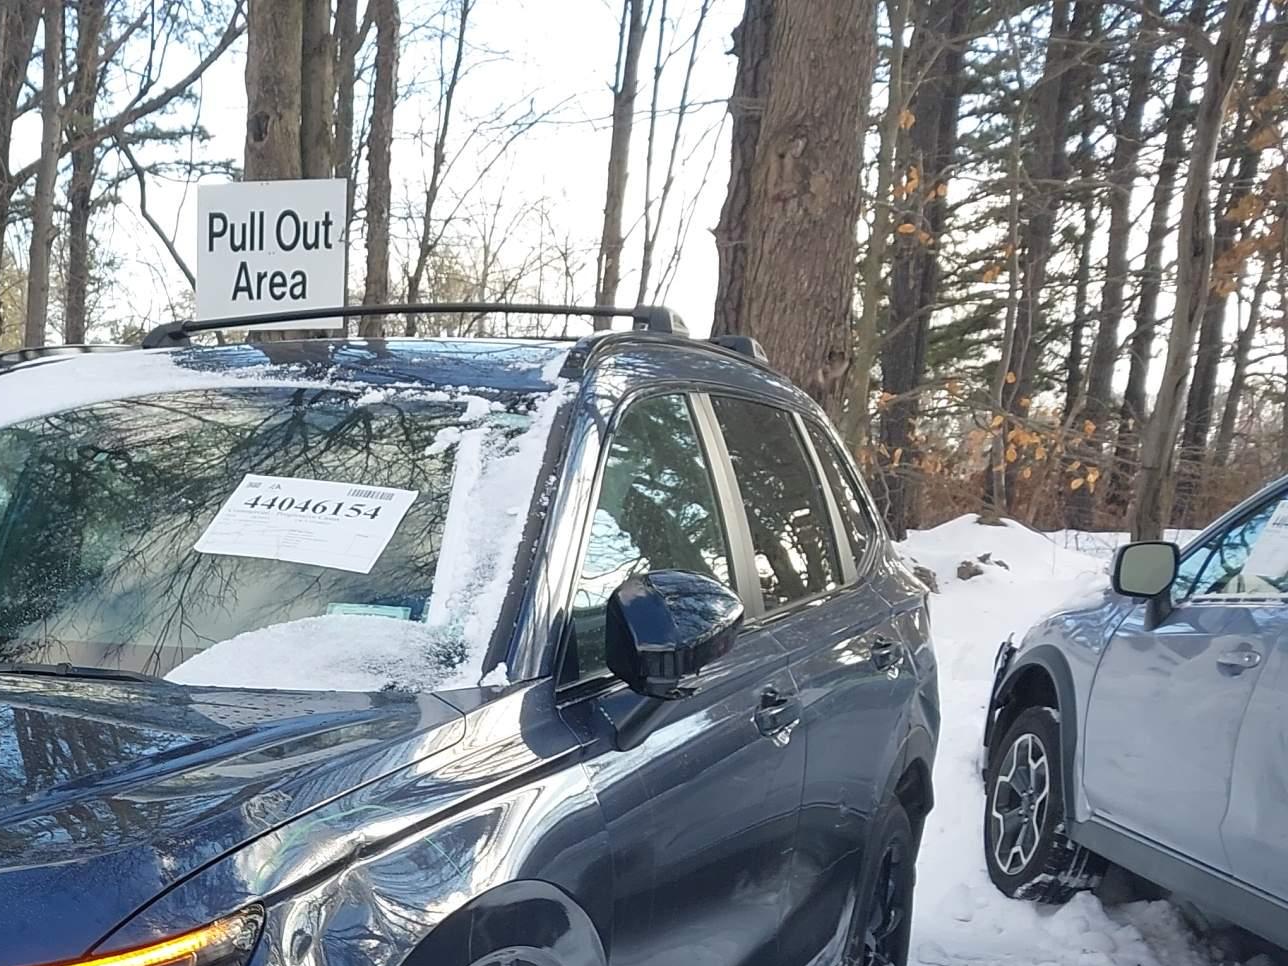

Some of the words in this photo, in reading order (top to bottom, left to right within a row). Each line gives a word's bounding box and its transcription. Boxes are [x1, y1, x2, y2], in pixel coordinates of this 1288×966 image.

[208, 211, 264, 252] Pull
[275, 209, 333, 252] Out
[231, 261, 307, 301] Area
[244, 494, 382, 520] 44046154
